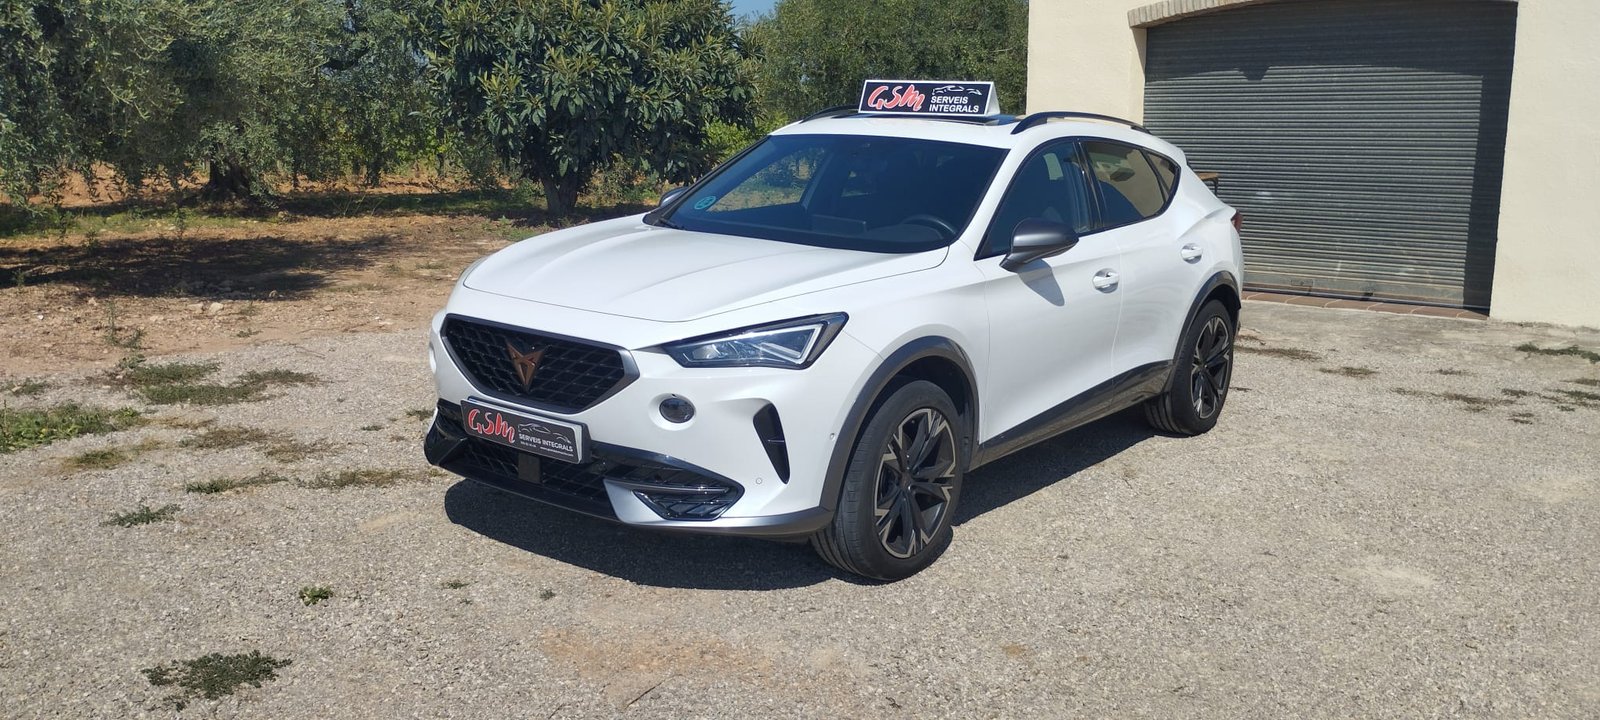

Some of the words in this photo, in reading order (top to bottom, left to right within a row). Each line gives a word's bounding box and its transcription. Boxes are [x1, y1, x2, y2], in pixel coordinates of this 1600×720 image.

[930, 95, 968, 104] SERVEIS
[929, 104, 979, 113] INTEGRALS
[518, 433, 541, 444] SERVEIS
[542, 439, 573, 452] INTEGRALS
